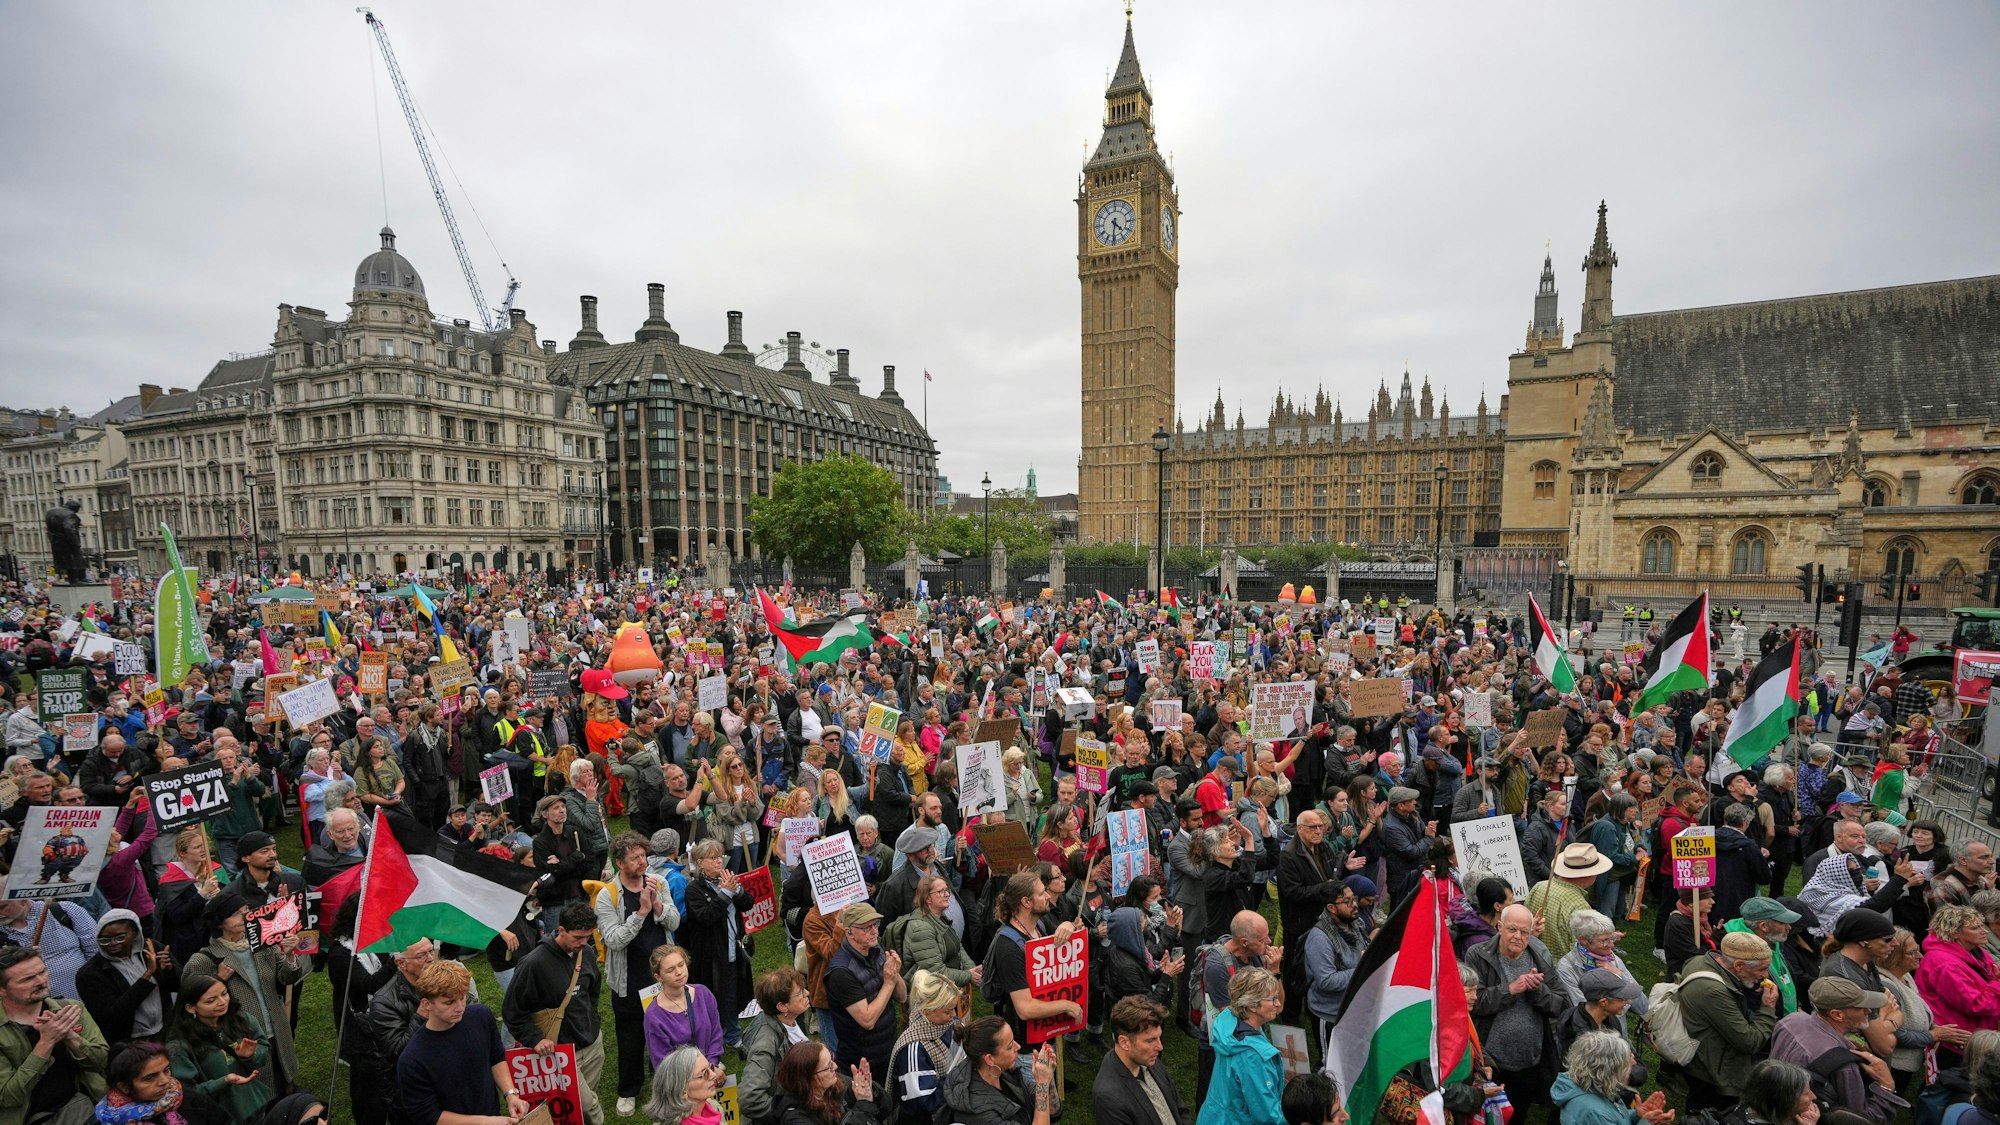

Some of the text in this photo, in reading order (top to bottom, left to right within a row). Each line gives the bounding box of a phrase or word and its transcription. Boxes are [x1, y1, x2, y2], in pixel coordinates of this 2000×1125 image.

[173, 630, 183, 666] Hackney
[1191, 643, 1214, 655] FUCK
[1194, 656, 1211, 667] YOU
[363, 664, 384, 672] TRUMP
[1190, 667, 1212, 678] TRUMP
[65, 674, 82, 682] THE
[362, 672, 383, 683] NOT
[42, 681, 82, 689] GENOCIDE
[42, 692, 82, 704] STOP
[43, 703, 84, 714] TRUMP
[1256, 702, 1279, 710] WHERE
[1078, 748, 1086, 757] NO
[1079, 756, 1103, 767] RACISM
[1079, 766, 1087, 775] NO
[151, 768, 223, 792] Stop Starving
[1078, 780, 1102, 791] TRUMP
[156, 779, 230, 820] GAZA
[1642, 800, 1658, 810] STOP
[46, 810, 101, 820] CRAPTAIN
[1476, 822, 1510, 832] DONALD:
[1484, 835, 1511, 845] LIBERATE
[1676, 839, 1704, 848] NO TO
[807, 837, 846, 855] FIGHT TRUMP
[1113, 843, 1148, 854] NOPE NOPE
[818, 845, 846, 859] STARMER
[1676, 847, 1710, 857] RACISM
[810, 852, 853, 872] NO TO WAR
[1677, 860, 1691, 869] NO
[813, 860, 855, 880] RACISM
[1496, 868, 1518, 878] LIST!
[1677, 869, 1690, 878] TO
[816, 870, 857, 888] CLIMATE CHAOS
[817, 875, 859, 894] CAPITALISM
[1677, 877, 1710, 887] TRUMP
[16, 884, 85, 898] FECK OFF HOME!
[246, 897, 287, 921] GOLDFISH
[745, 907, 775, 930] STOP
[246, 922, 260, 952] TRUMP
[265, 934, 283, 946] GO
[1032, 938, 1084, 970] STOP
[1032, 960, 1084, 987] TRUMP
[512, 1052, 569, 1079] STOP
[515, 1073, 572, 1095] TRUMP
